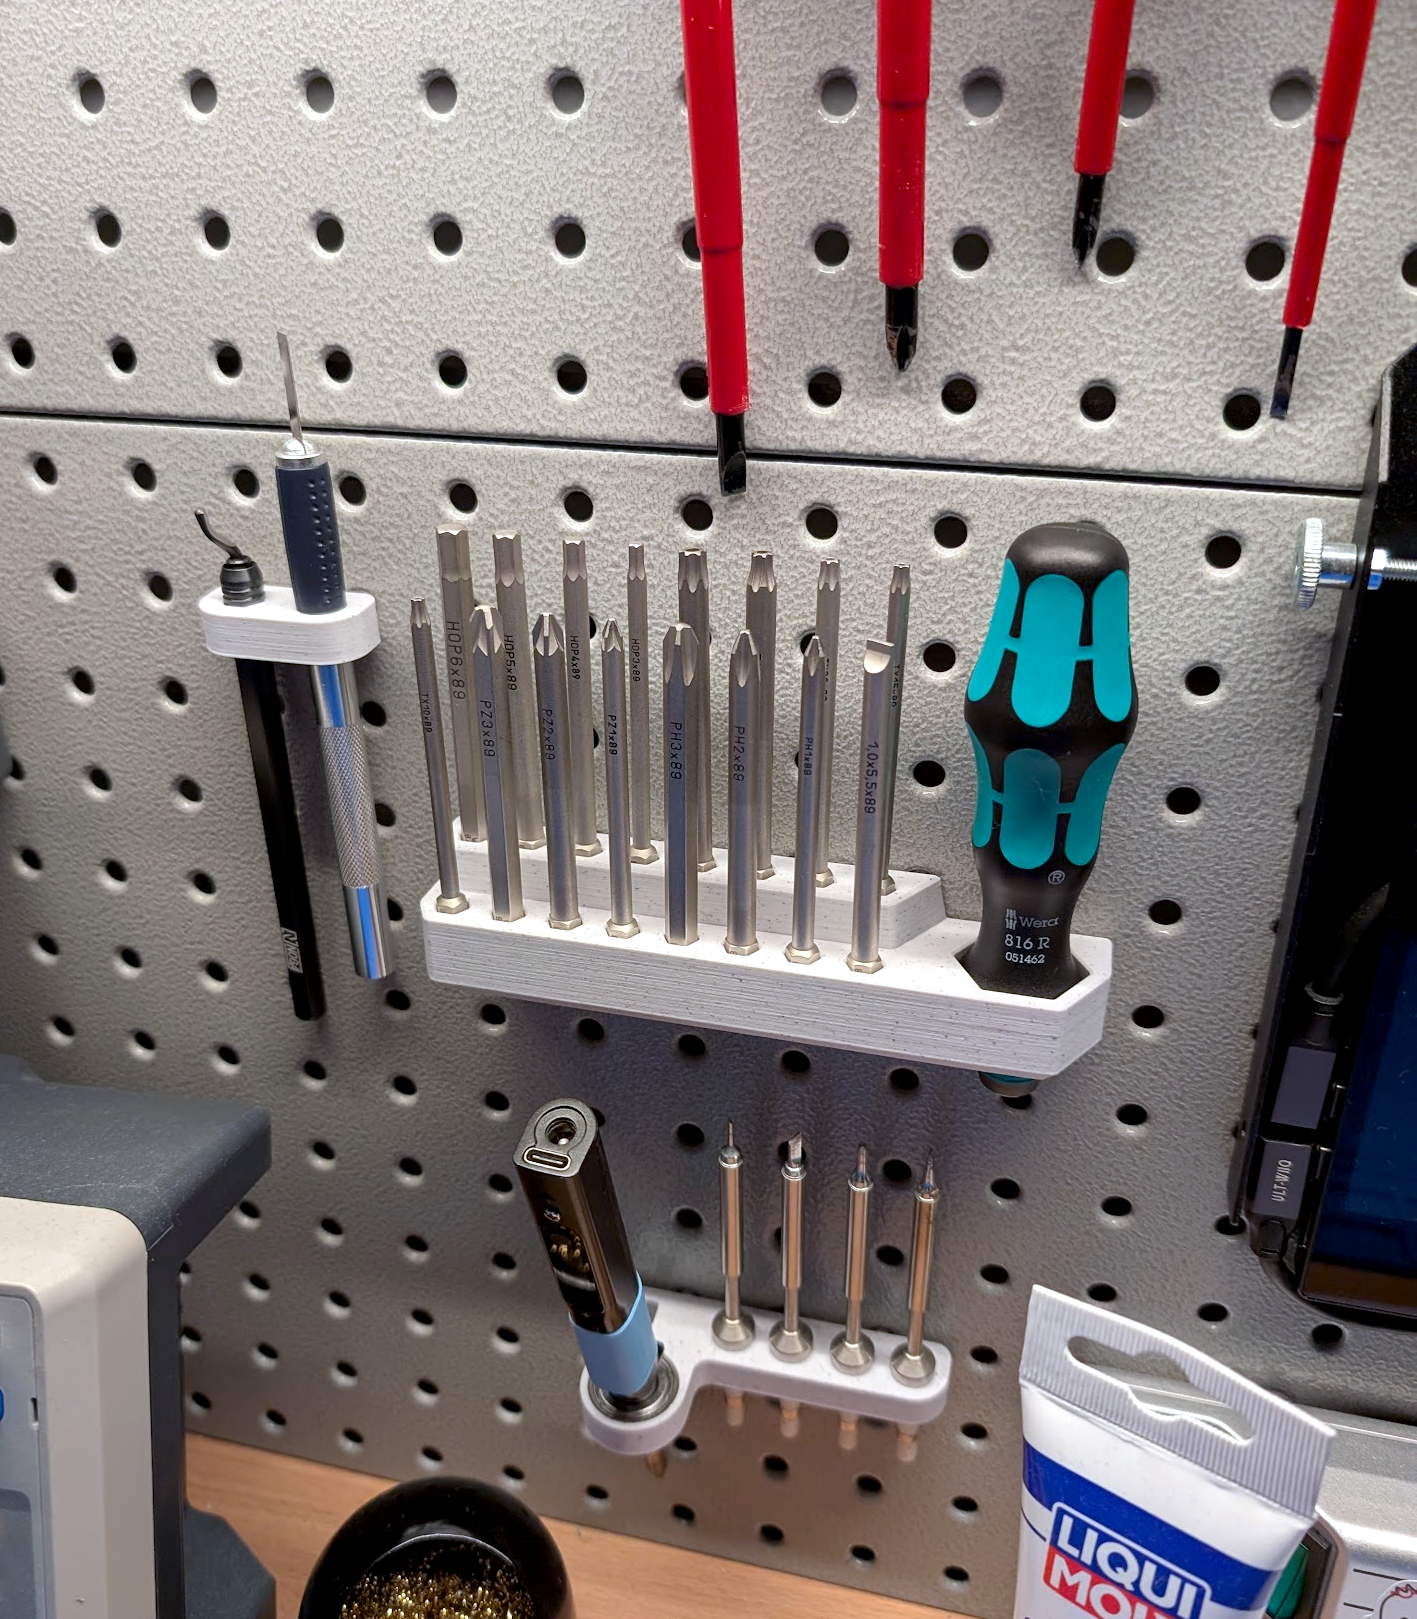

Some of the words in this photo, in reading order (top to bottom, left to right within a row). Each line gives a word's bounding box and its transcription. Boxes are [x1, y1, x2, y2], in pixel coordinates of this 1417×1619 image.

[447, 621, 466, 700] HOP6x89
[504, 635, 517, 691] HOP5x89
[570, 635, 581, 680] HOP4x89
[631, 638, 641, 682] HOP3x89
[421, 693, 433, 733] TX10x89
[480, 700, 496, 757] PZ3x89
[542, 709, 556, 760] PZ2x89
[608, 714, 618, 755] PZ1x89
[670, 721, 683, 780] PH3x89
[733, 725, 745, 782] PH2x89
[803, 737, 814, 776] PH1x89
[864, 741, 879, 814] 1,0x5,5x89
[1004, 933, 1034, 950] 816
[1037, 936, 1050, 950] R
[1018, 916, 1060, 928] Wera
[1004, 951, 1046, 964] 051462
[1050, 1553, 1170, 1619] MO
[1056, 1514, 1198, 1619] LIQUI
